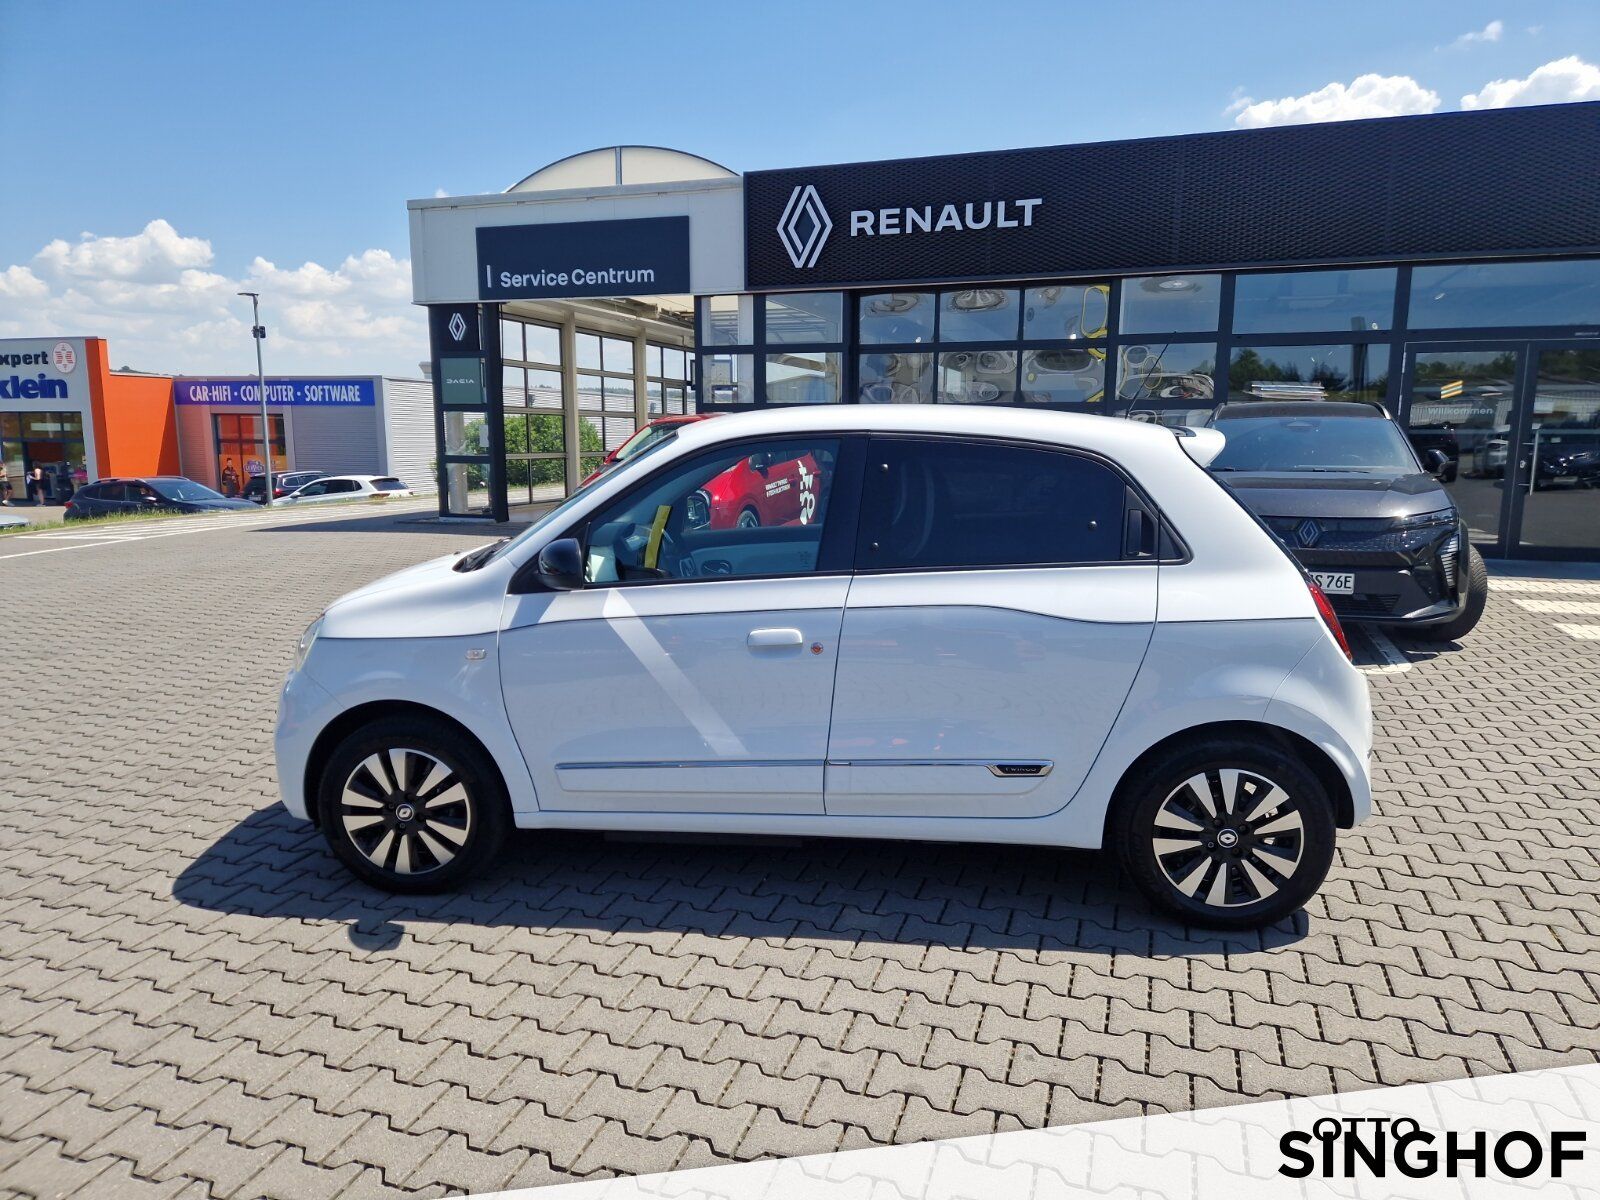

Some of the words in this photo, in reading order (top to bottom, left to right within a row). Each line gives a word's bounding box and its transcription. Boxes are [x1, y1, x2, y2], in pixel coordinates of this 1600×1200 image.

[850, 198, 1043, 237] RENAULT
[500, 269, 568, 288] Service
[571, 268, 655, 286] Centrum
[189, 386, 231, 402] CAR-HIFI
[304, 385, 360, 402] SOFTWARE
[1427, 406, 1493, 415] Willkommen
[1326, 575, 1352, 589] 76E
